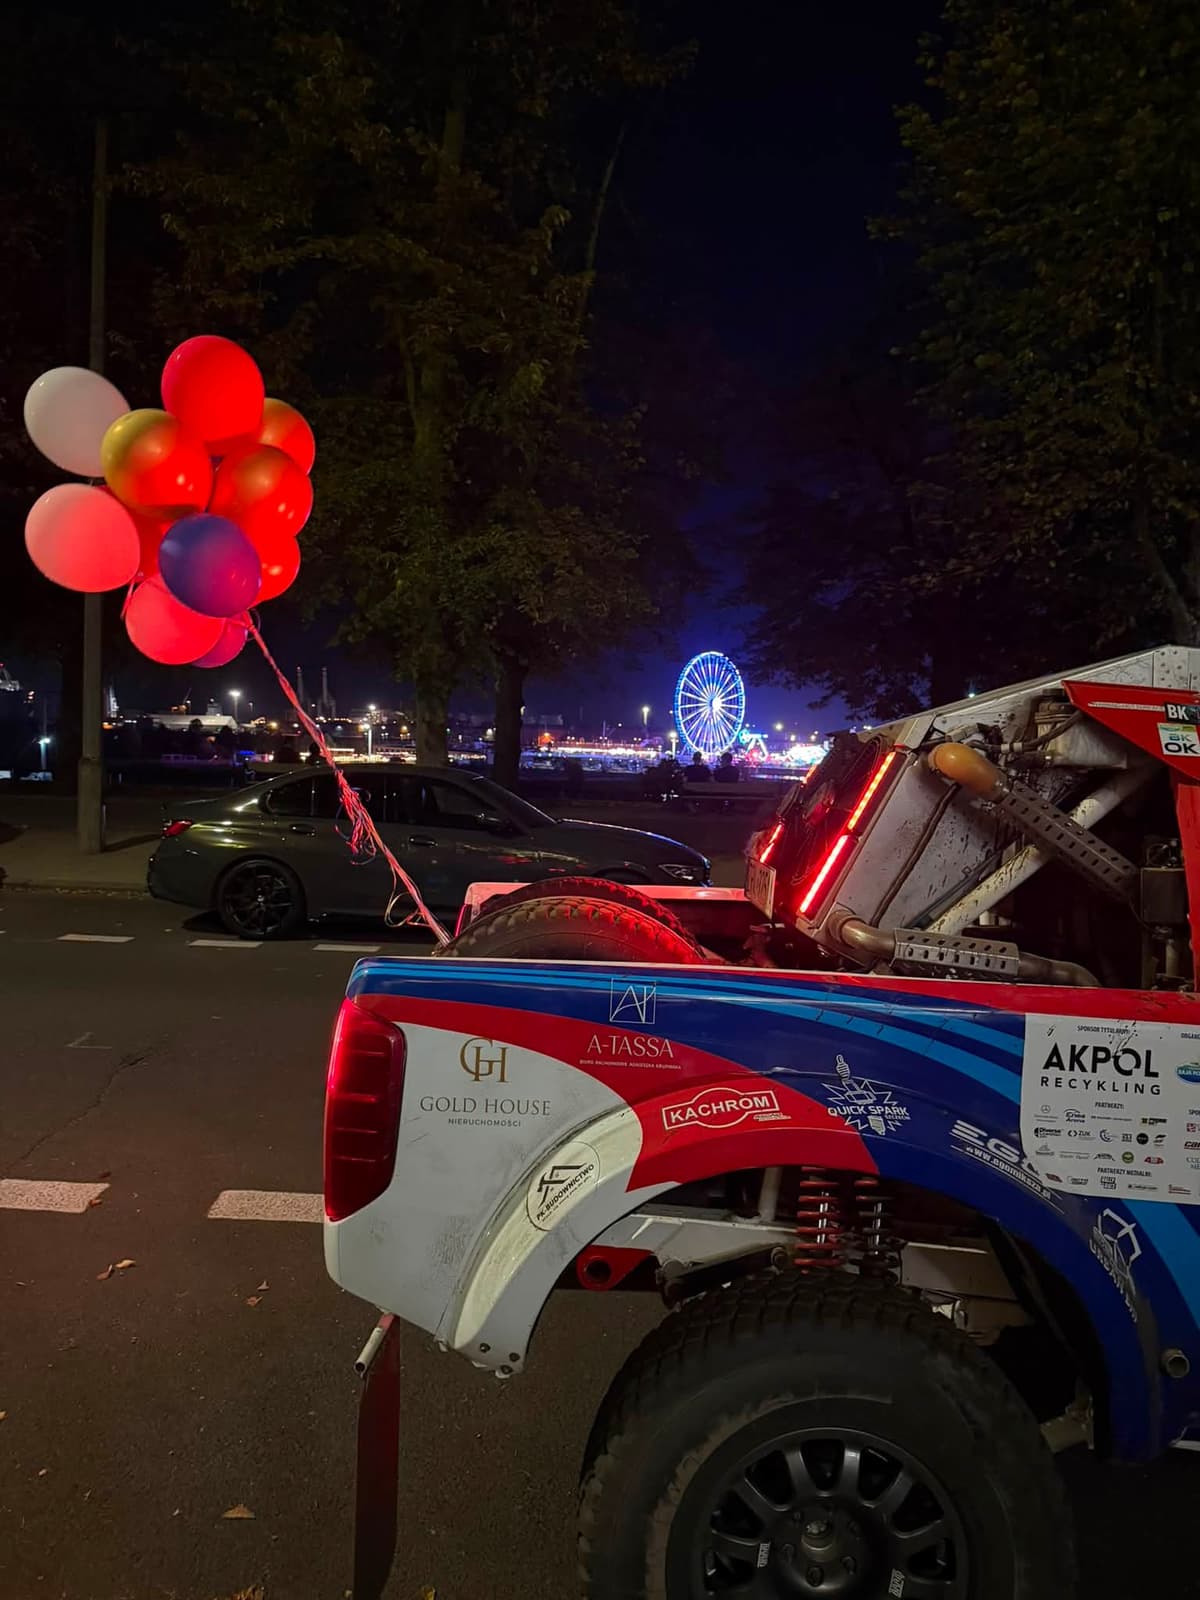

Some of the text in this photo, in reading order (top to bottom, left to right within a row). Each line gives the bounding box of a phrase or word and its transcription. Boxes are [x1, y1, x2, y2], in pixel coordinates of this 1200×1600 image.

[1167, 704, 1189, 720] BK
[1164, 742, 1200, 754] OK
[1077, 1025, 1100, 1033] SPONSOR
[587, 1034, 674, 1058] A-TASSA
[1042, 1042, 1159, 1079] AKPOL
[1041, 1076, 1161, 1096] RECYKLING
[420, 1096, 551, 1116] GOLD HOUSE
[670, 1095, 770, 1123] KACHROM
[828, 1105, 910, 1117] QUICK SPARK
[448, 1117, 521, 1128] NIERUCHOMOŚCI
[536, 1163, 595, 1221] PK-BUDOWNICTWO
